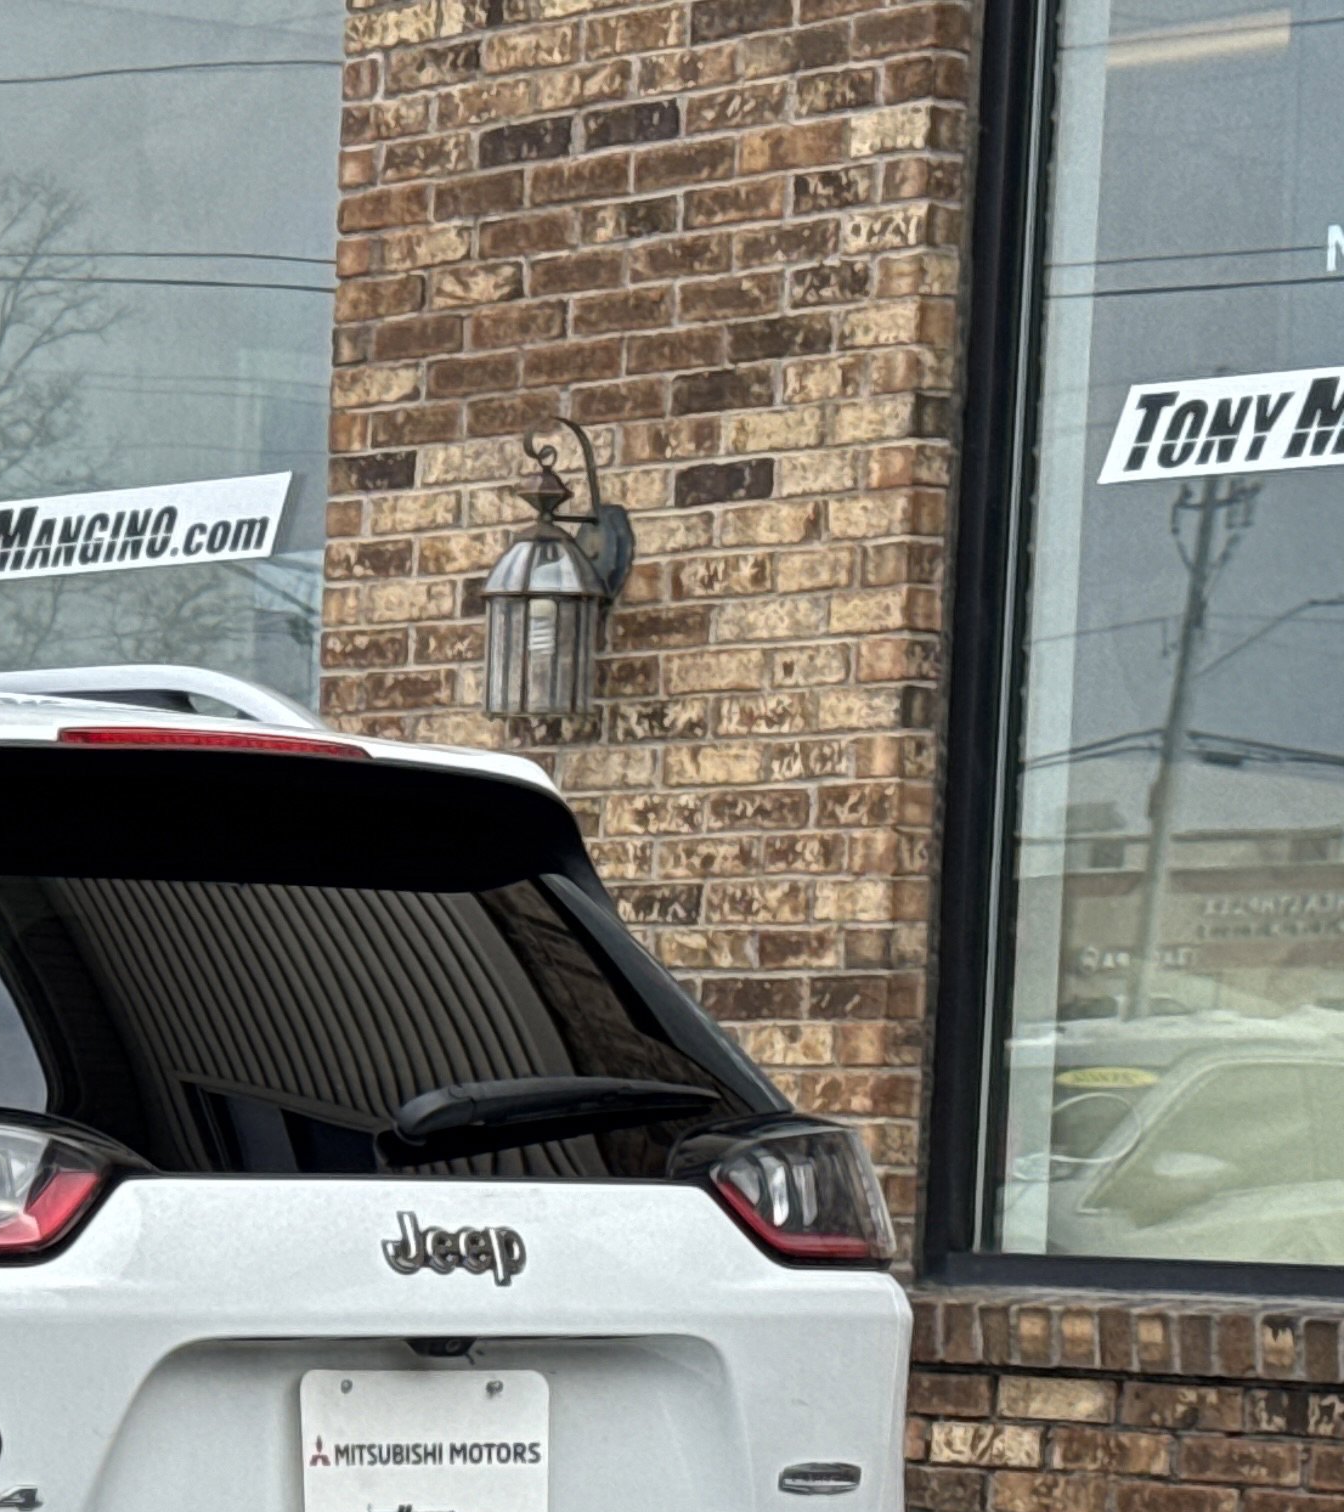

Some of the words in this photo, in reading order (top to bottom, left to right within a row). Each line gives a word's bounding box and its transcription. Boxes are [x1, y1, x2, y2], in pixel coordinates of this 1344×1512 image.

[381, 1211, 527, 1287] Jeep
[334, 1443, 444, 1467] MITSUBISHI
[449, 1442, 542, 1465] MOTORS
